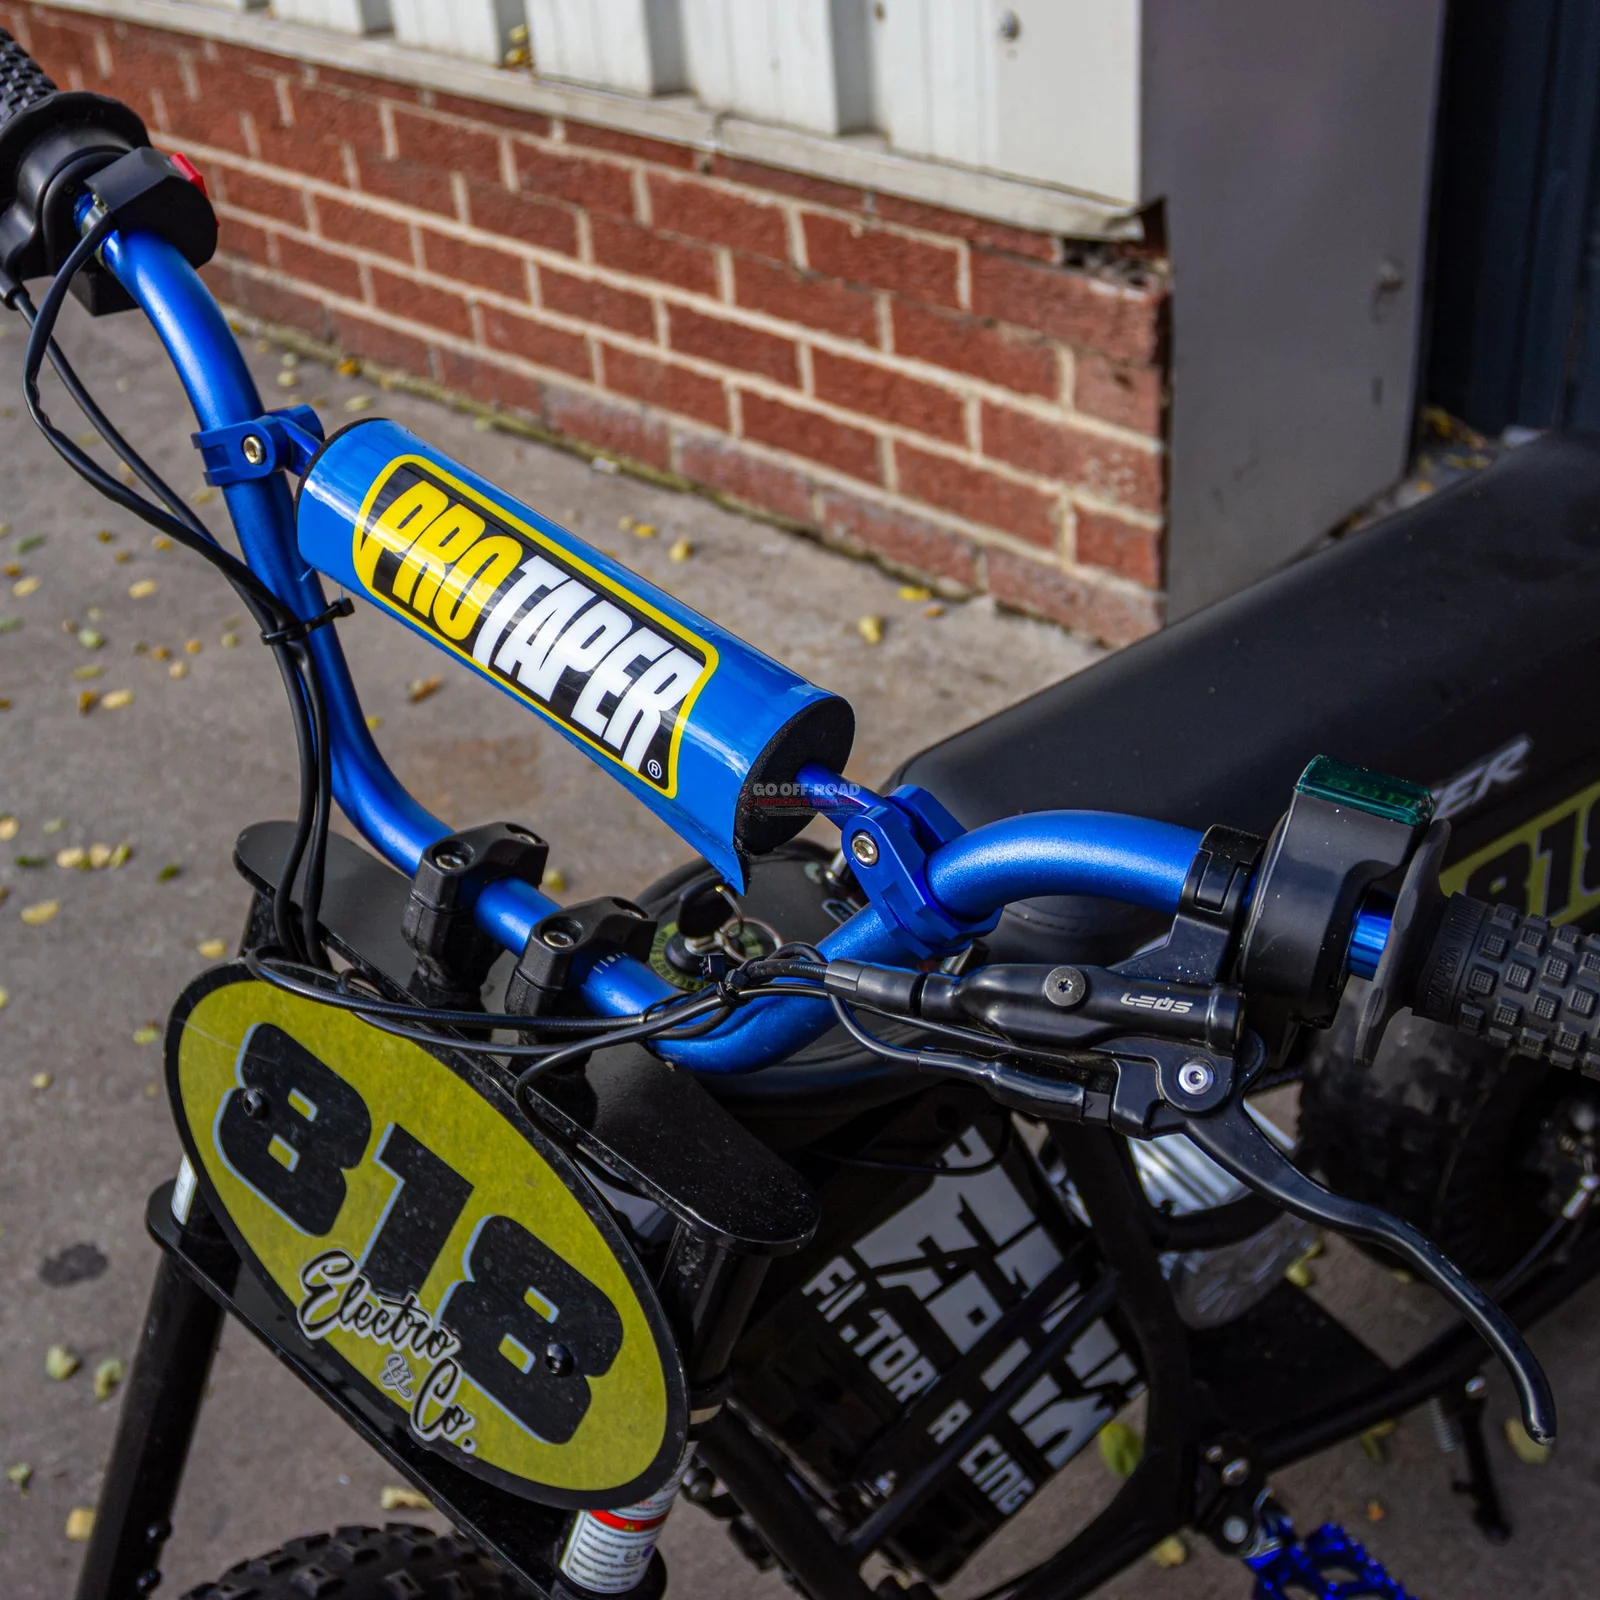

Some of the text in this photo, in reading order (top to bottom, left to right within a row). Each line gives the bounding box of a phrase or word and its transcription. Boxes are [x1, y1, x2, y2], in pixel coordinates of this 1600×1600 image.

[212, 1022, 624, 1445] 818
[298, 1248, 461, 1364] Electro
[380, 1352, 476, 1454] & Co.
